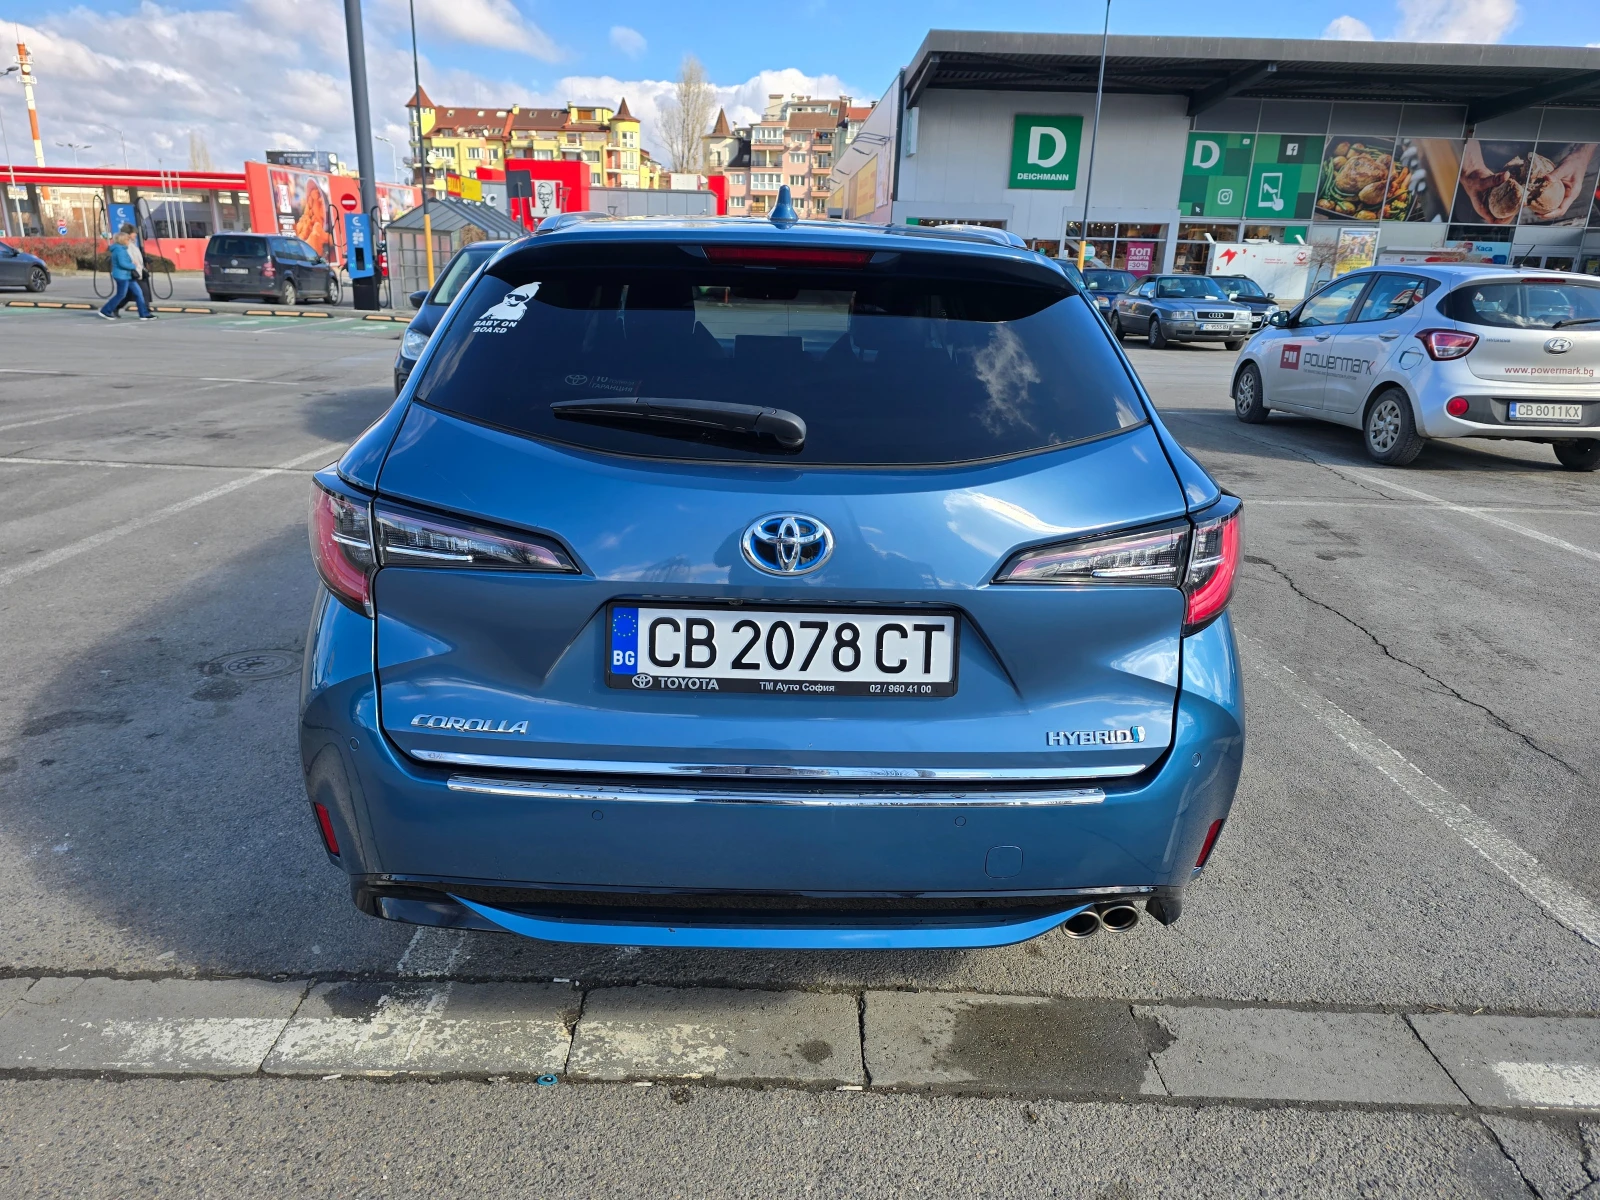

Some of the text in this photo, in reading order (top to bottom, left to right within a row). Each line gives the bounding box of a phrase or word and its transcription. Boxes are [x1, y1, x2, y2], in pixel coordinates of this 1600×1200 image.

[1027, 126, 1067, 168] D
[1192, 140, 1220, 169] D
[1017, 172, 1069, 181] DEICHMANN
[1130, 247, 1151, 256] ТОП
[472, 326, 508, 334] BOARD
[1504, 366, 1594, 377] www.powermark.bg
[1518, 404, 1533, 416] CB
[1536, 405, 1562, 417] 8011
[1565, 406, 1580, 417] KX
[648, 617, 946, 674] CB 2078 CT
[613, 650, 635, 666] BG
[658, 677, 719, 690] TOYOTA
[776, 682, 799, 691] Ауто
[802, 683, 835, 693] София
[869, 684, 881, 693] 02
[888, 685, 905, 693] 960
[906, 685, 918, 693] 41
[920, 685, 932, 693] 00
[410, 713, 529, 734] COROLLA
[1046, 729, 1133, 746] HYBRID
